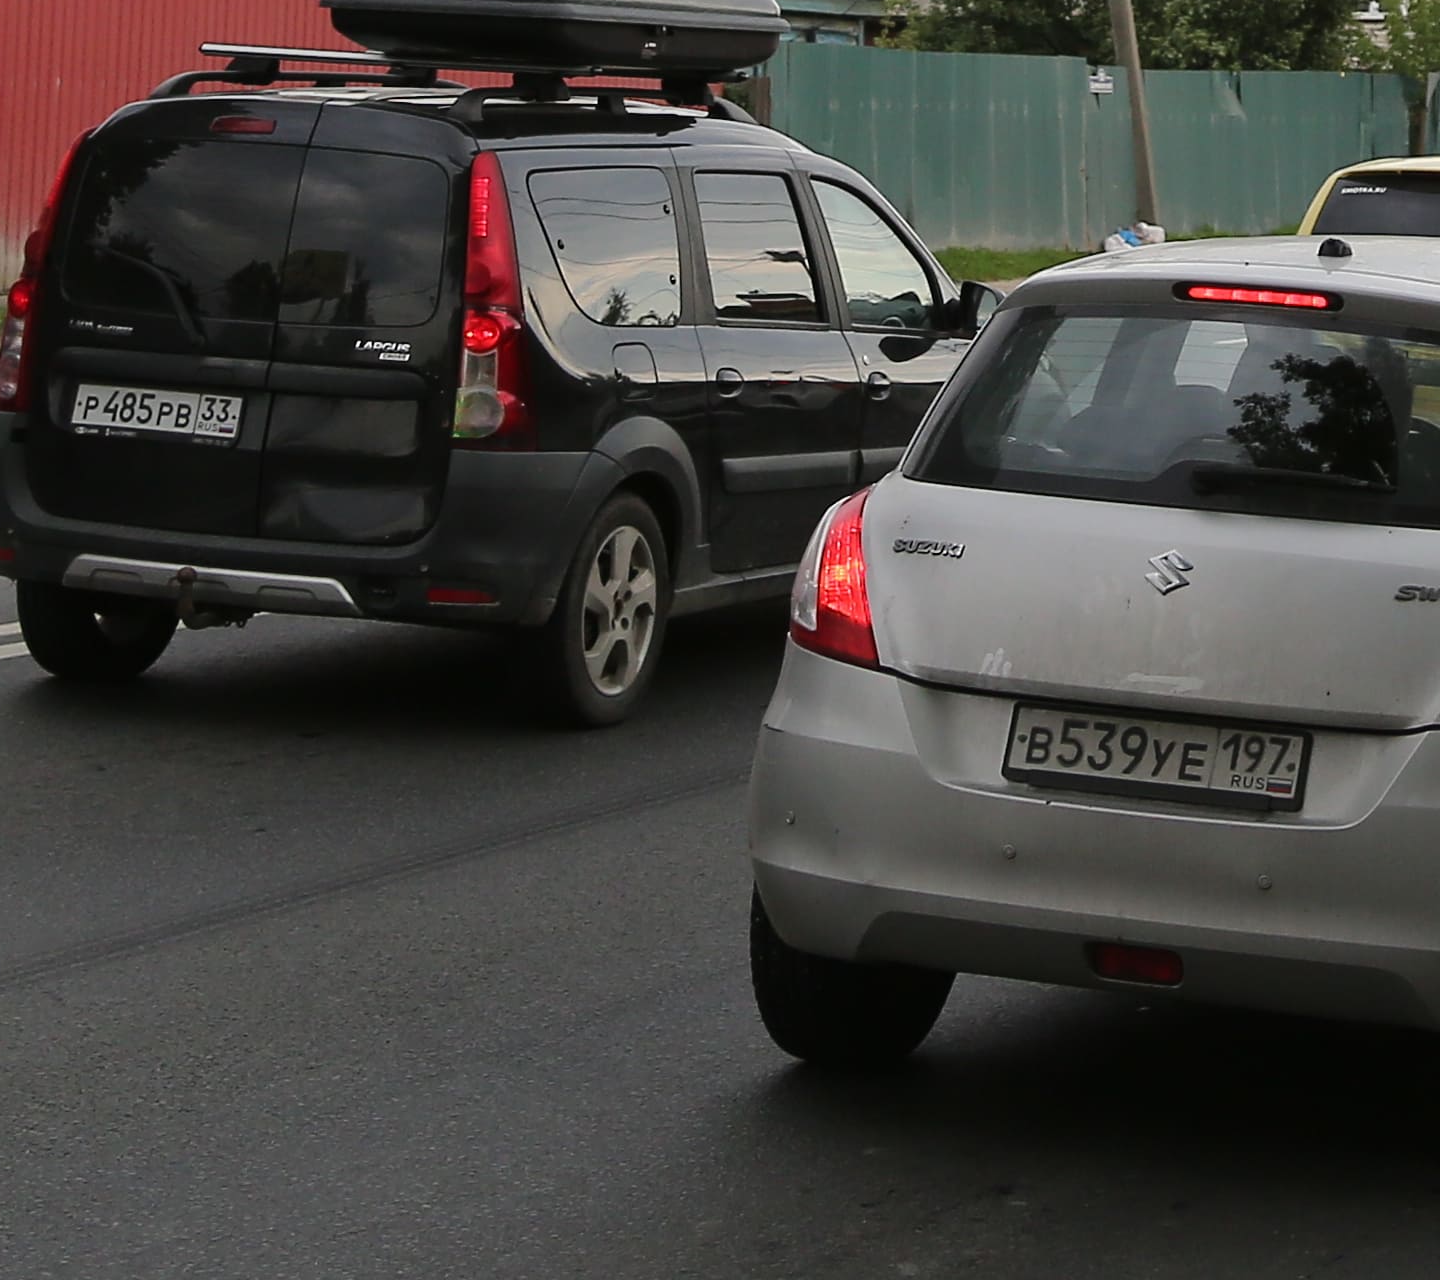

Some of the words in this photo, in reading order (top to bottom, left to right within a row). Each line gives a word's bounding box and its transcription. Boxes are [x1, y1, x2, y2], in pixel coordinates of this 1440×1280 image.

[355, 340, 411, 354] LARGUS
[200, 396, 230, 423] 33
[198, 421, 218, 432] RUS
[893, 539, 966, 559] SUZUKI
[1222, 733, 1291, 775] 197
[1231, 774, 1265, 791] RUS
